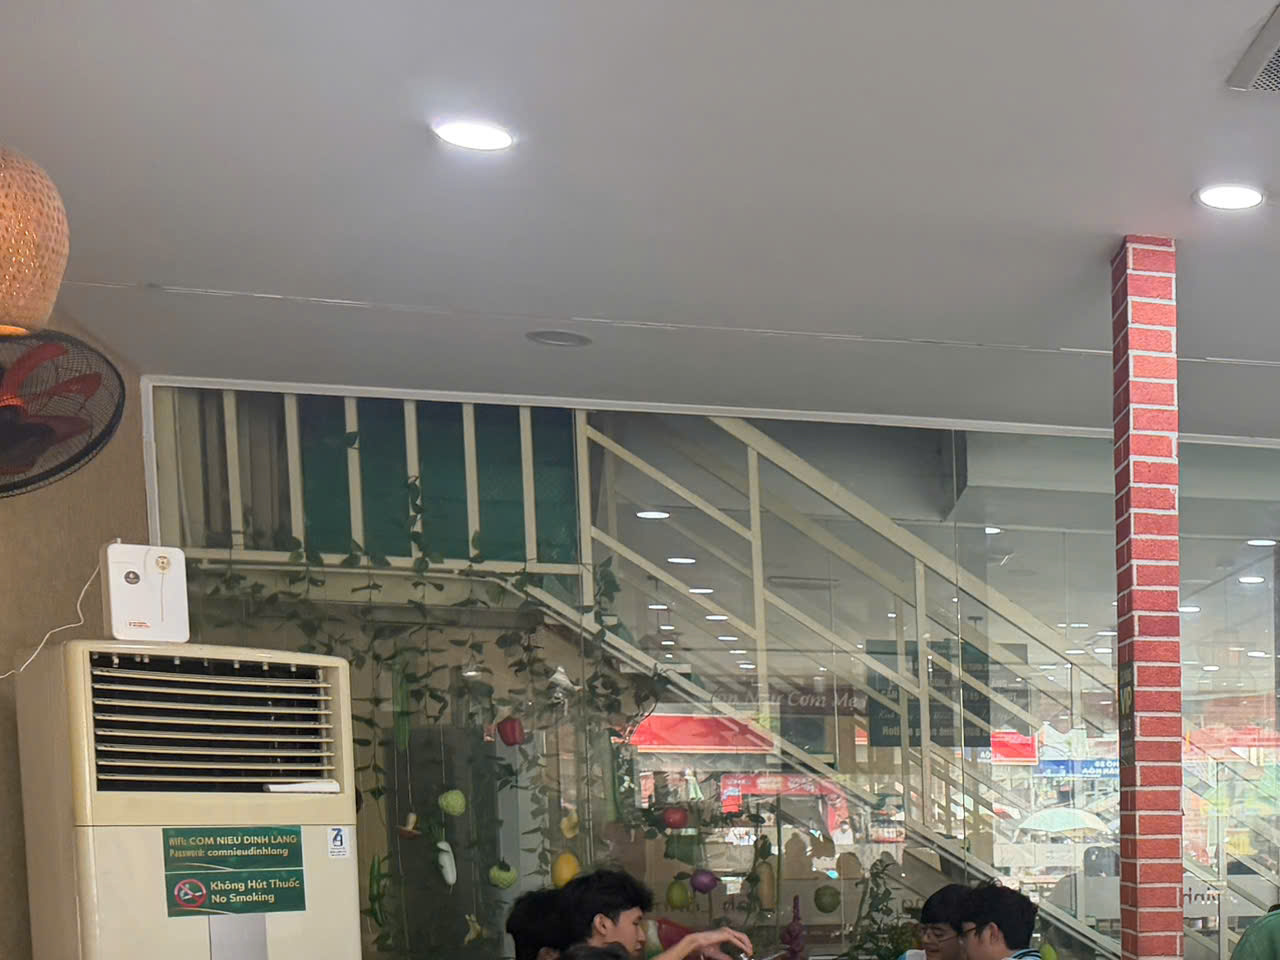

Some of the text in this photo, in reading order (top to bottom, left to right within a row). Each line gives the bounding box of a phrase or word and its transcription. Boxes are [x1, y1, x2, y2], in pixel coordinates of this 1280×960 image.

[189, 836, 214, 847] COM
[216, 835, 242, 845] NIEU
[243, 835, 269, 844] DINH
[271, 834, 297, 844] LANG
[207, 847, 289, 857] comnieudinhlang
[210, 876, 300, 892] Không Hút Thuốc
[211, 892, 275, 904] No Smoking
